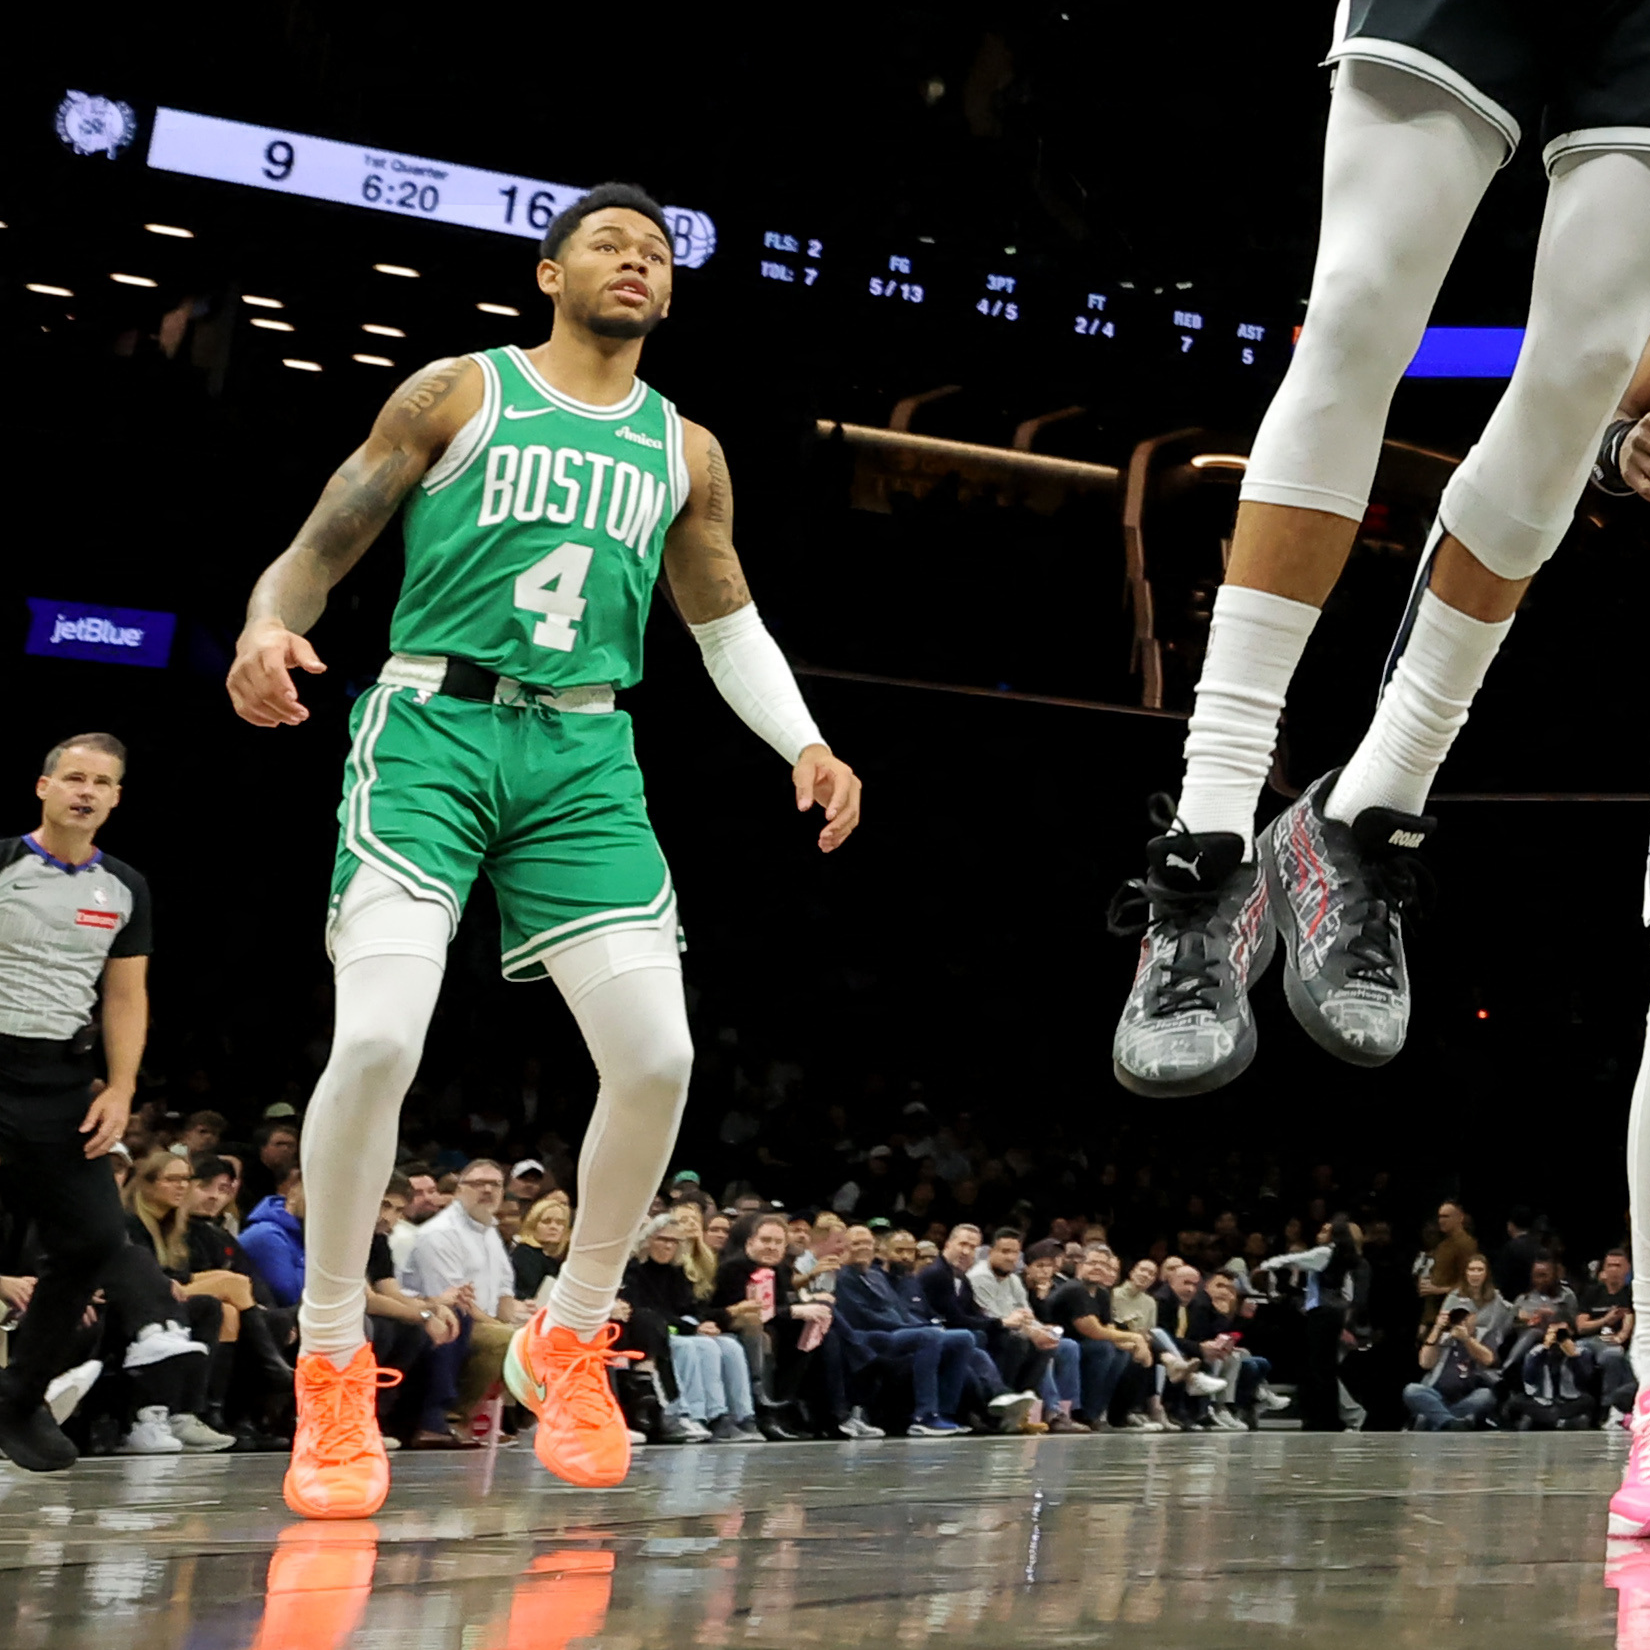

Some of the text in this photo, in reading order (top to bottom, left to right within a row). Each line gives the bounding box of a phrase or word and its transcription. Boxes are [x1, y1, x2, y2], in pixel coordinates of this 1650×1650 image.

[261, 140, 294, 182] 9
[498, 184, 556, 231] 16
[361, 174, 440, 214] 6:20
[807, 238, 823, 259] 2
[804, 267, 818, 287] 7
[1088, 293, 1107, 311] FT
[1074, 316, 1116, 338] 2/4
[1236, 322, 1266, 342] AST
[1180, 335, 1193, 353] 7
[614, 426, 663, 450] Amica
[477, 445, 667, 559] BOSTON
[513, 541, 594, 653] 4
[50, 613, 145, 647] jetBlue
